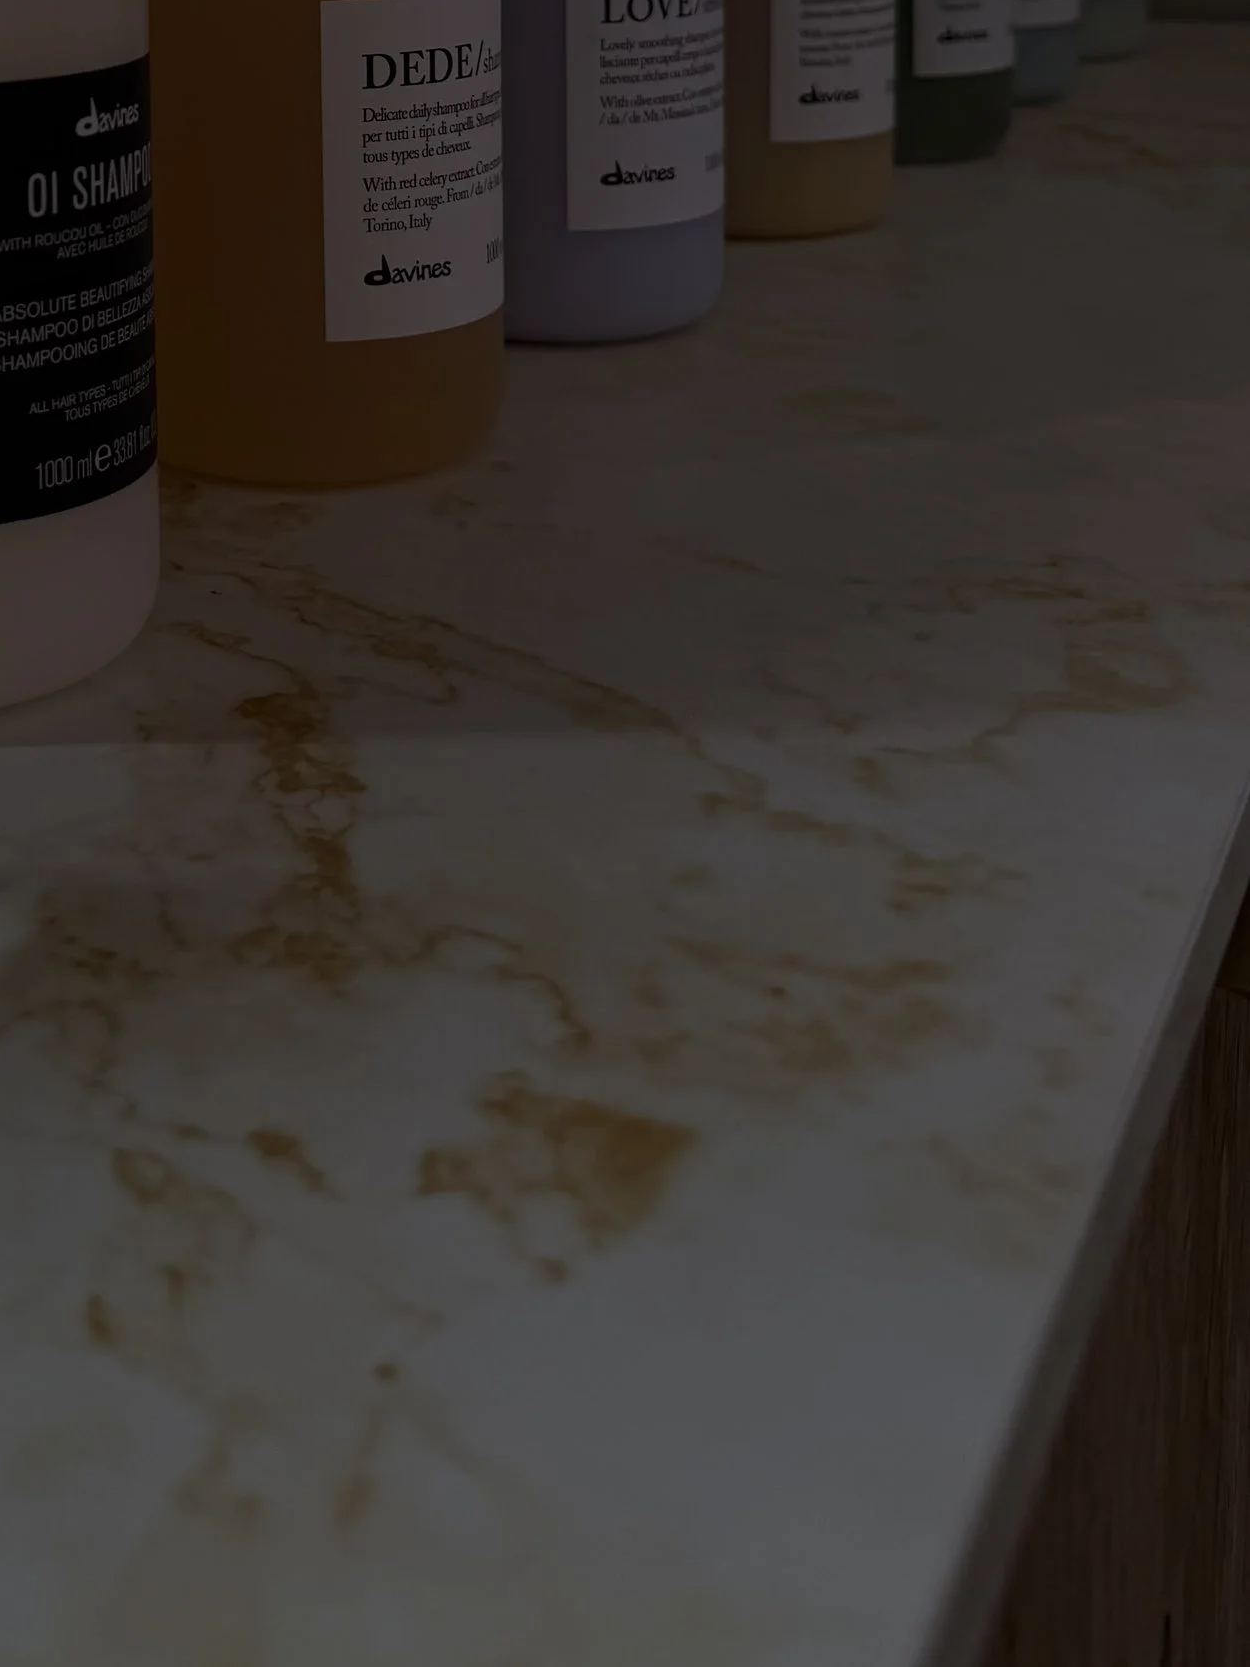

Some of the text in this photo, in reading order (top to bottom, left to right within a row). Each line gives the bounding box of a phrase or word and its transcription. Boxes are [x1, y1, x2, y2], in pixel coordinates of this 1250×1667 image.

[600, 37, 635, 53] Lovely
[361, 40, 499, 90] DEDE/sh
[362, 107, 409, 123] Delicate
[409, 102, 433, 122] daily
[432, 101, 470, 118] shampoo
[600, 94, 629, 109] With
[74, 95, 140, 138] davines
[362, 131, 383, 149] per
[385, 126, 409, 142] tutti
[412, 125, 416, 139] i
[419, 122, 436, 142] tipi
[437, 120, 447, 135] di
[363, 152, 389, 164] tous
[391, 148, 420, 166] types
[421, 143, 435, 158] de
[363, 175, 397, 193] With
[399, 173, 417, 190] red
[418, 171, 448, 189] celery
[599, 159, 676, 186] davines
[27, 169, 59, 219] OI
[363, 198, 379, 213] de
[381, 195, 412, 211] céleri
[414, 194, 445, 210] rouge.
[446, 187, 470, 204] From
[34, 224, 88, 248] ROUCOU
[88, 221, 105, 237] OIL
[362, 213, 433, 234] Torino, Italy
[56, 242, 87, 260] AVEC
[88, 234, 114, 254] HUILE
[115, 229, 126, 245] DE
[363, 254, 452, 286] davines
[80, 270, 143, 308] BEAUTIFYING
[82, 313, 96, 332] DI
[97, 294, 144, 328] BELLEZZA
[100, 330, 116, 352] DE
[28, 400, 50, 415] ALL
[51, 394, 77, 411] HAIR
[78, 383, 107, 404] TYPES
[64, 404, 92, 422] TOUS
[92, 393, 118, 414] TYPES
[119, 388, 128, 404] DE
[34, 455, 74, 491] 1000
[77, 449, 93, 479] ml
